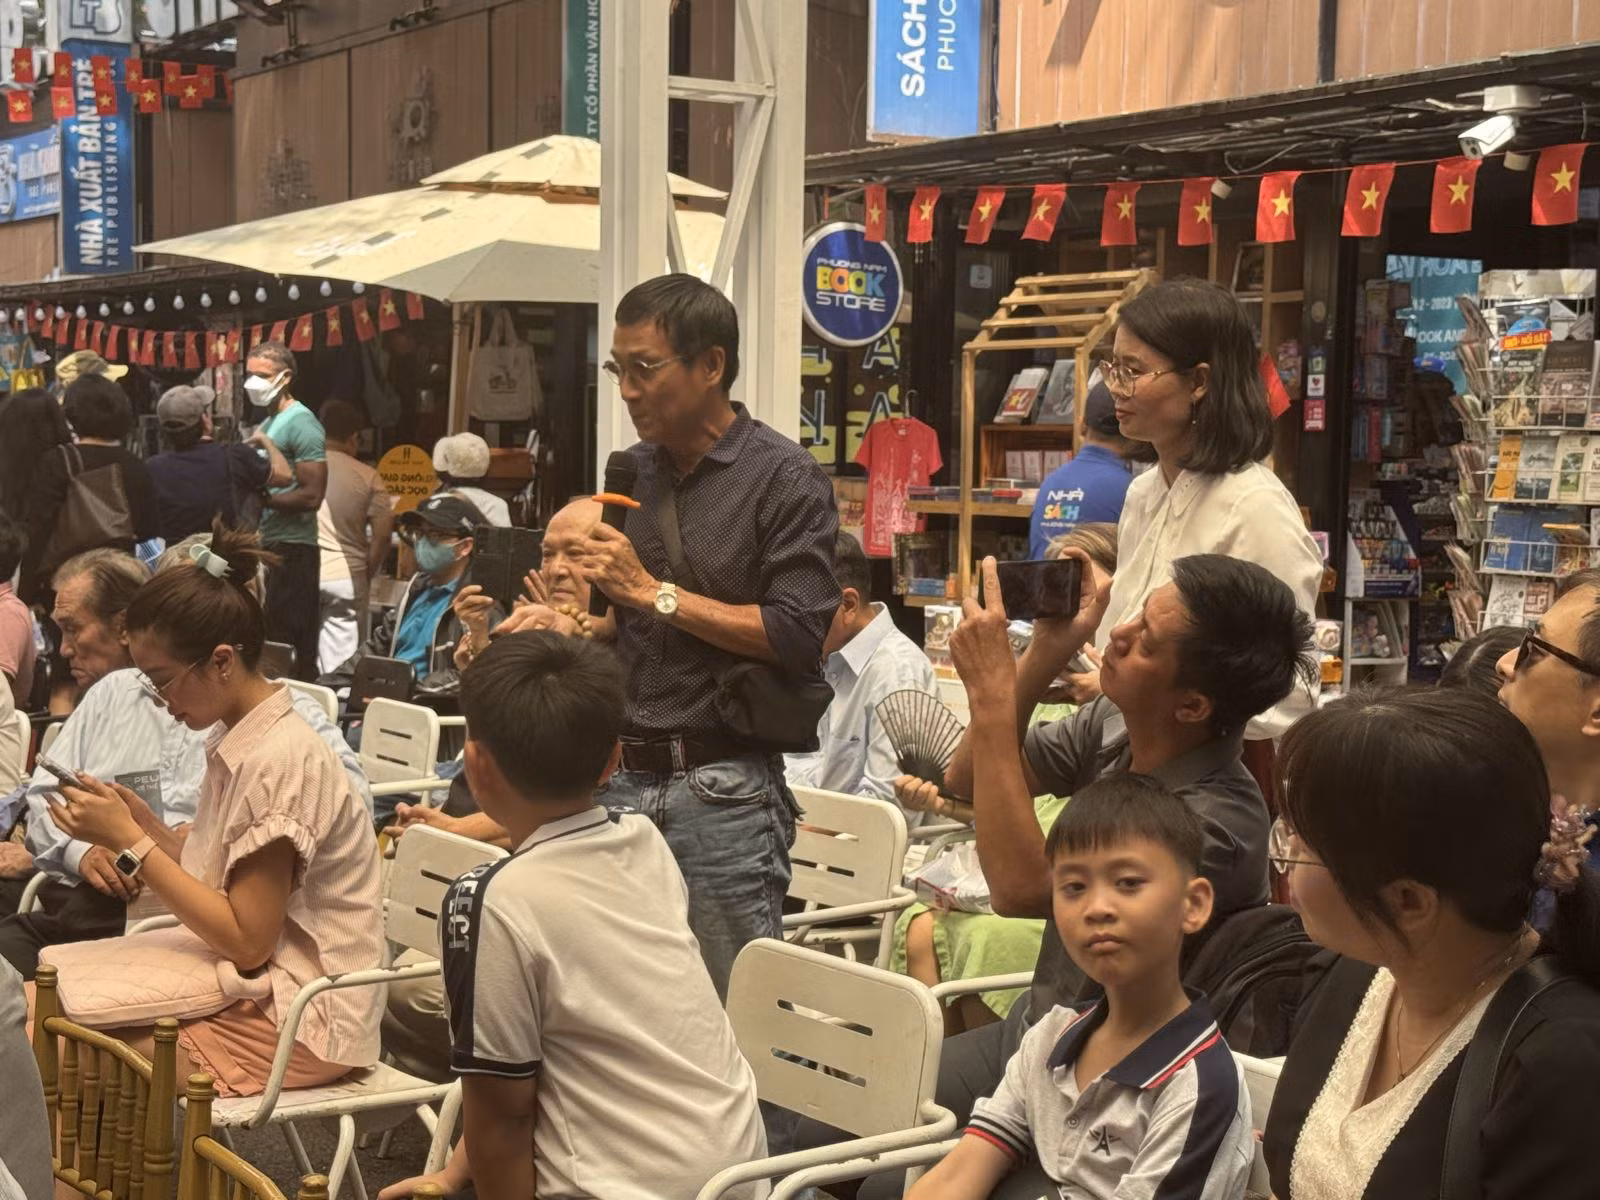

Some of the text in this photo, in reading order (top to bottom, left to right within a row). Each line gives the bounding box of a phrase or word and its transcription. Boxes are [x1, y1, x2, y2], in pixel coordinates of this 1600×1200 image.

[896, 0, 927, 97] SÁCH
[69, 103, 102, 153] BẢN
[587, 117, 598, 135] TY
[70, 156, 103, 213] XUẤT
[104, 122, 119, 229] PUBLISHING
[75, 218, 103, 265] NHÀ
[816, 265, 886, 297] BOOK
[816, 291, 886, 312] STORE
[1043, 502, 1080, 520] SÁCH
[1047, 487, 1085, 501] NHÀ
